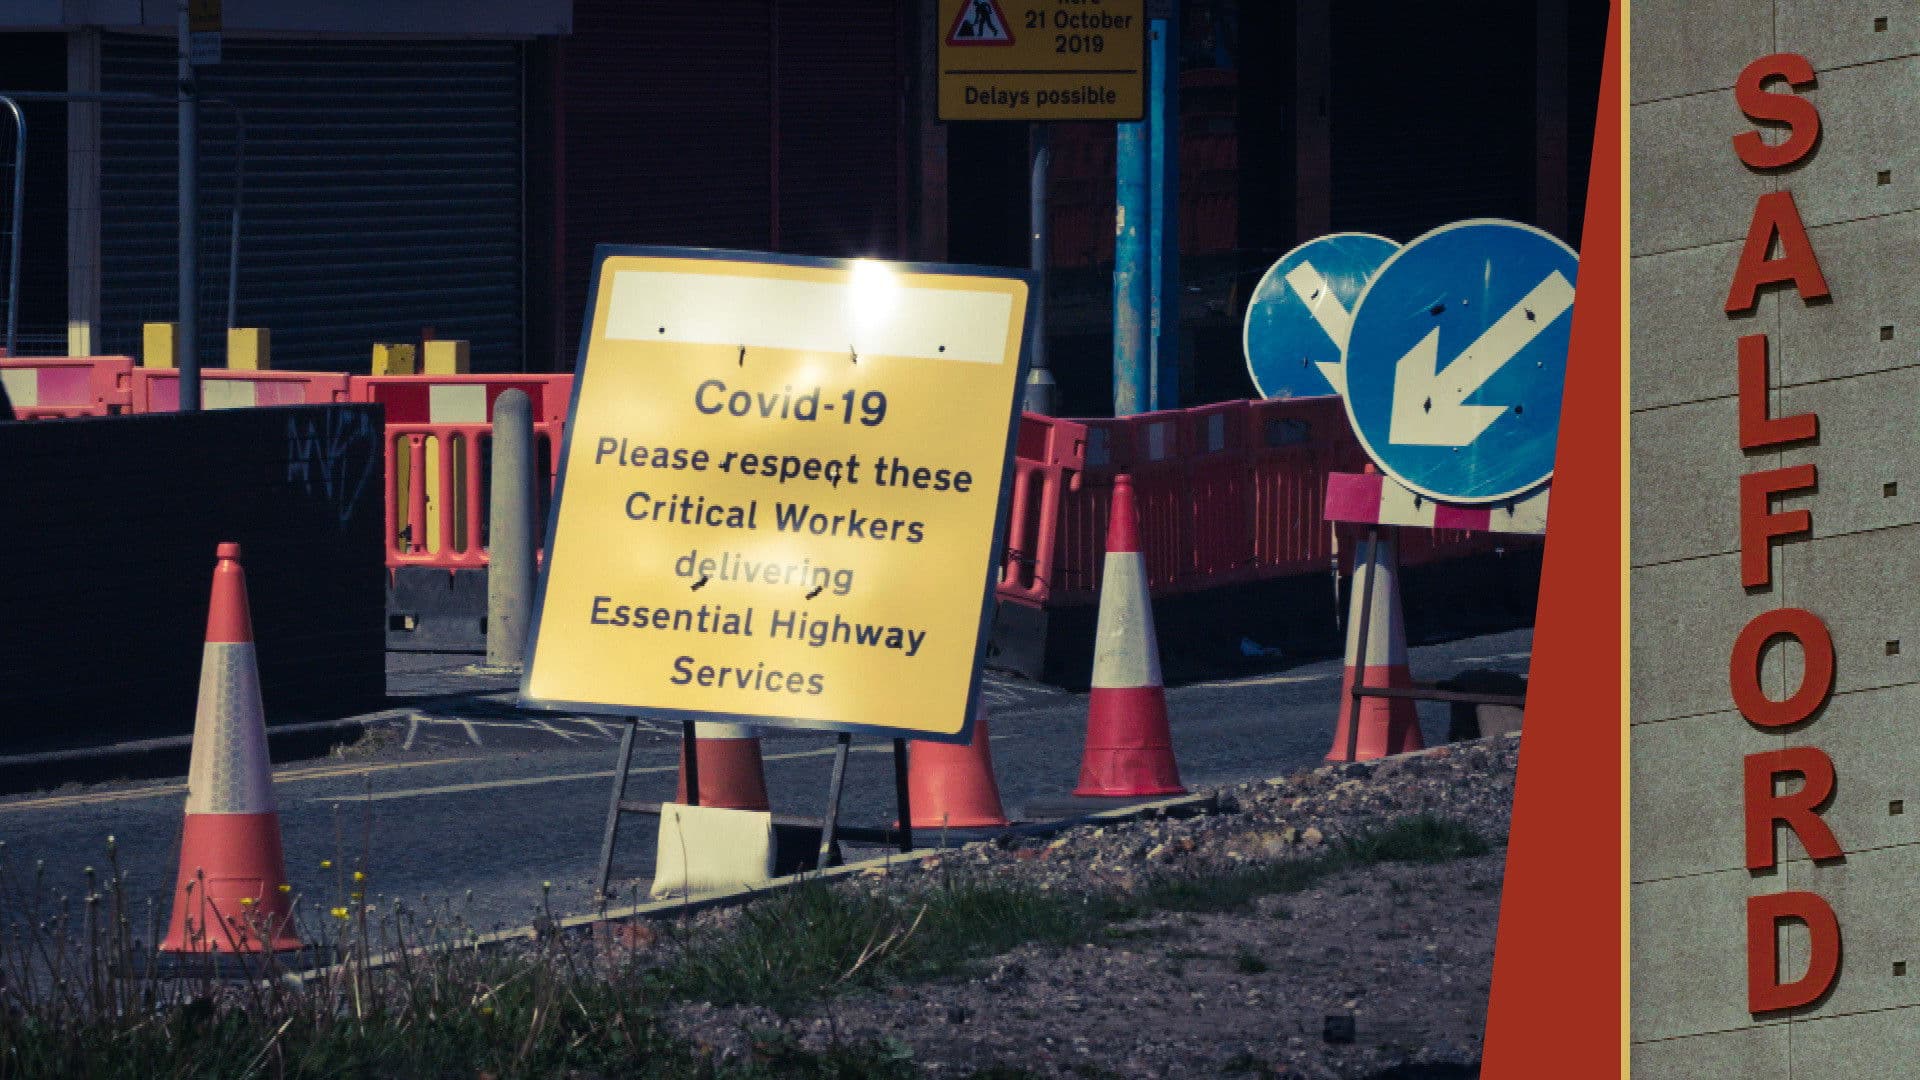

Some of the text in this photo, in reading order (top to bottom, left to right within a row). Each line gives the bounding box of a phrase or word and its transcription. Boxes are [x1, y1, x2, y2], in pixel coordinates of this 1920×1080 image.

[1024, 8, 1132, 29] 21 October
[1056, 35, 1104, 53] 2019
[965, 85, 1117, 108] Delays possible
[695, 379, 887, 427] Covid-19
[595, 436, 973, 493] Please respect these
[625, 491, 925, 543] Critical Workers
[1724, 53, 1844, 1014] SALFORD
[674, 549, 854, 596] delivering
[590, 595, 926, 657] Essential Highway
[670, 655, 825, 695] Services
